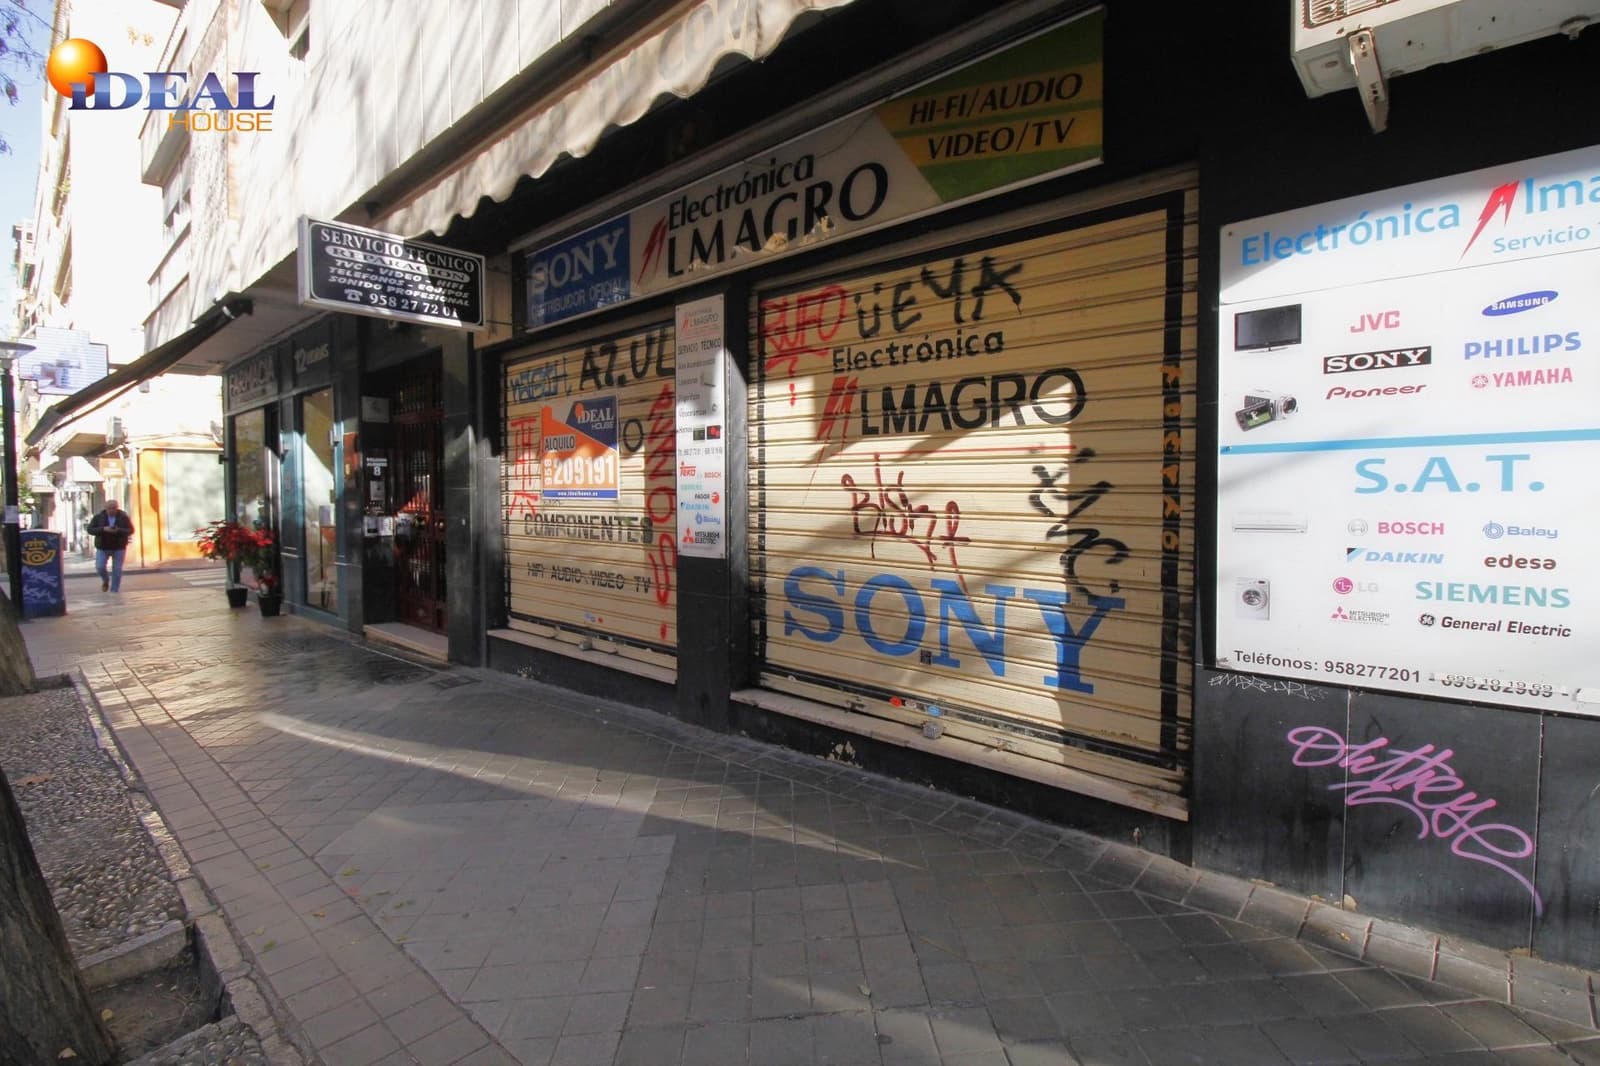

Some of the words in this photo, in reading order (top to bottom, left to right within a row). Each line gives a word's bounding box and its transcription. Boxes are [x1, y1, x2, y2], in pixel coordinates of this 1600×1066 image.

[909, 72, 1084, 125] HI-FI/AUDIO
[667, 153, 815, 231] Electrónica
[1242, 202, 1460, 266] Electrónica
[1493, 224, 1591, 253] Servicio
[321, 228, 403, 258] SERVICIO
[407, 246, 475, 273] TECNICO
[531, 228, 625, 296] SONY
[328, 266, 404, 286] TELEFONOS
[335, 258, 363, 271] TVC
[379, 267, 422, 282] VIDEO
[328, 275, 382, 291] SONIDO
[386, 286, 470, 306] PROFESIONAL
[370, 293, 397, 307] 958
[401, 299, 418, 311] 27
[423, 302, 439, 315] 72
[1490, 296, 1550, 312] SAMSUNG
[1350, 310, 1400, 333] JVC
[832, 329, 1004, 374] Electrónica
[1464, 331, 1582, 360] PHILIPS
[1326, 348, 1428, 372] SONY
[1493, 367, 1573, 388] YAMAHA
[591, 421, 614, 430] HOUSE
[545, 436, 575, 451] ALQUILO
[373, 466, 381, 476] 8
[553, 455, 614, 485] 209191
[1354, 454, 1545, 494] S.A.T.
[695, 531, 720, 539] MITSUBISHI
[1377, 521, 1445, 536] BOSCH
[1506, 525, 1559, 540] Balay
[1365, 551, 1445, 565] DAIKIN
[1484, 554, 1557, 571] edesa
[551, 565, 581, 585] AUDIO
[590, 570, 625, 590] VIDEO
[633, 575, 651, 594] TV
[1358, 582, 1379, 593] LG
[1415, 581, 1571, 609] SIEMENS
[1349, 610, 1390, 618] MITSUBISHI
[1349, 615, 1384, 623] ELECTRIC
[783, 566, 1126, 694] SONY
[1441, 616, 1501, 633] General
[1507, 619, 1572, 638] Electric
[1233, 650, 1319, 672] Teléfonos:
[1324, 660, 1421, 684] 958277201
